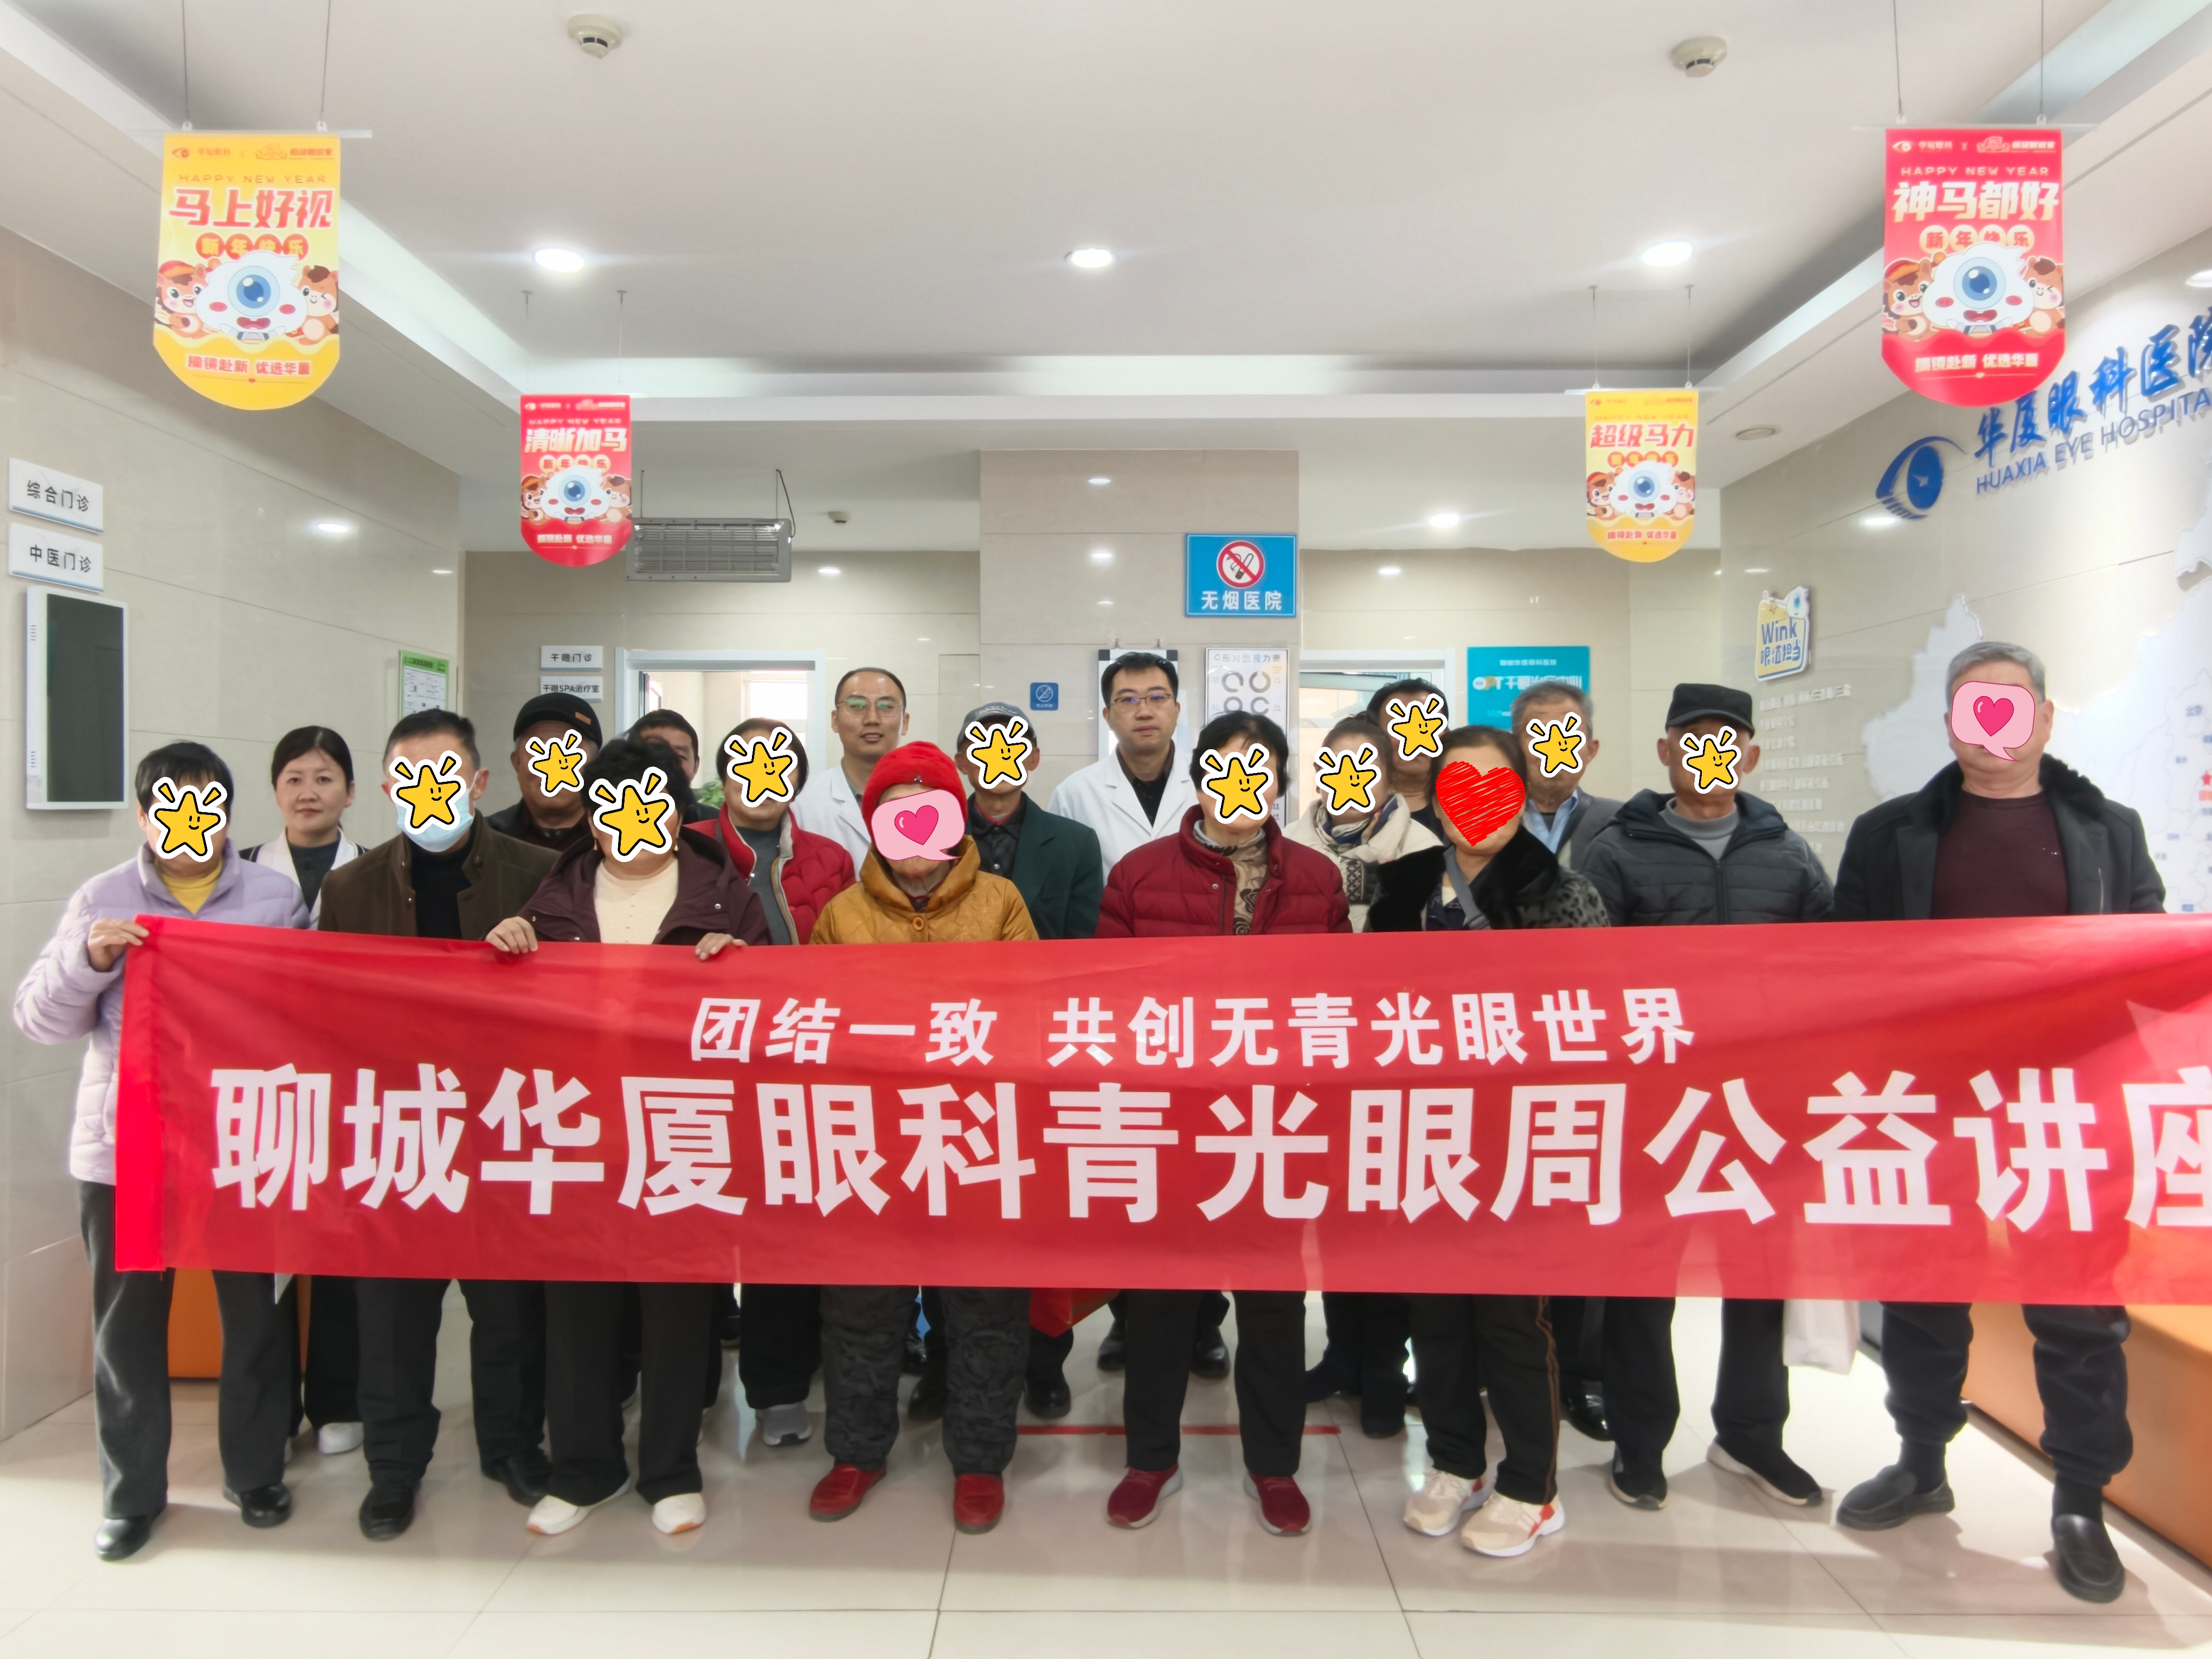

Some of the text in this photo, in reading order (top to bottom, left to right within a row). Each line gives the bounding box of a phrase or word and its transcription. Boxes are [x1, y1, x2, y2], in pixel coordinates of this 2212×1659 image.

[179, 174, 326, 183] HAPPY NEW YEAR
[1901, 166, 2049, 176] HAPPY NEW YEAR
[169, 188, 334, 229] 马上好视
[1892, 181, 2060, 223] 神马都好
[524, 427, 627, 453] 清晰加马
[1590, 423, 1695, 448] 超级马力
[1977, 452, 2047, 494] HUAXIA
[2055, 432, 2094, 464] EYE
[26, 479, 89, 513] 综合门诊
[29, 544, 92, 573] 中医门诊
[1201, 590, 1282, 611] 无烟医院
[1761, 616, 1797, 645] Wink
[691, 987, 1695, 1069] 团结一致 共创无青光眼世界
[210, 1063, 2212, 1232] 聊城华厦眼科青光眼周公益讲座
